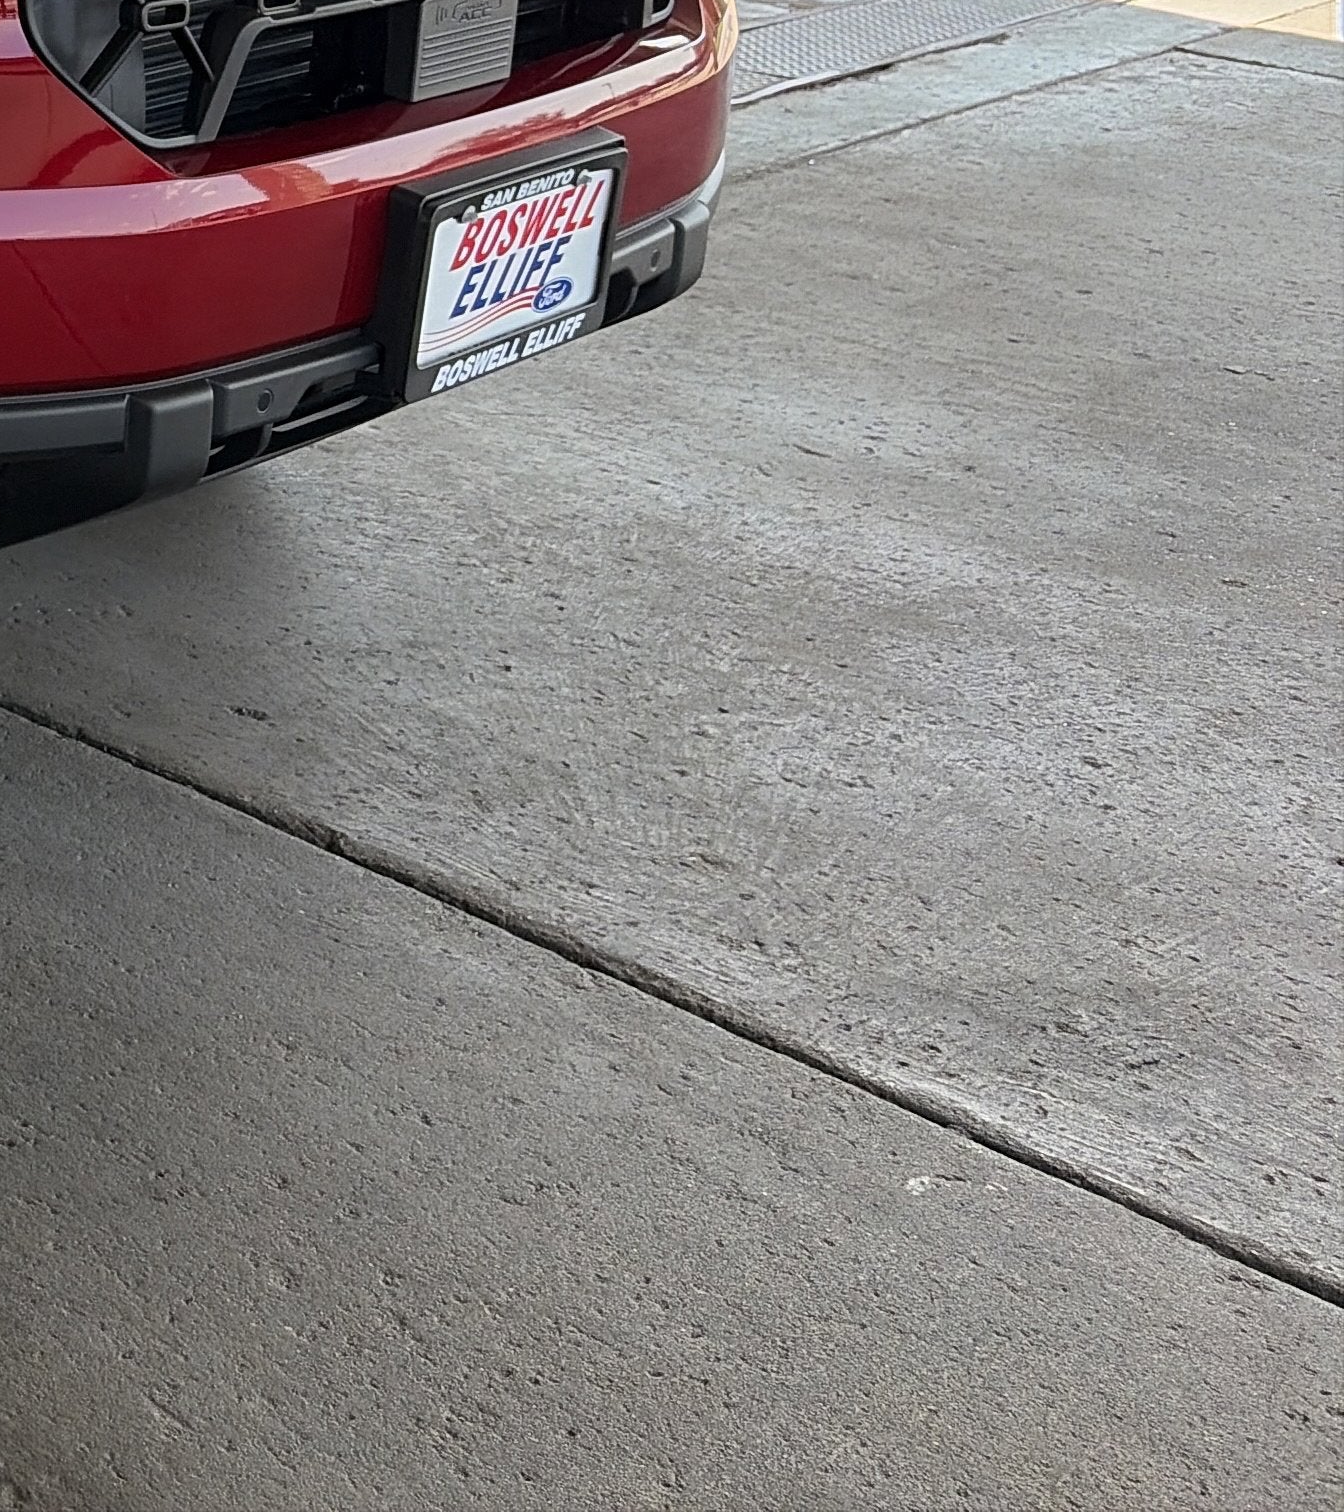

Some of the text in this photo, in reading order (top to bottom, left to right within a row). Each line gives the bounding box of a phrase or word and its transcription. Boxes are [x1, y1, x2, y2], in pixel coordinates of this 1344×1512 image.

[459, 6, 492, 22] ACC
[449, 180, 605, 272] BOSWELL
[480, 168, 575, 211] SAN BENITO
[448, 234, 573, 319] ELLIFF
[431, 313, 586, 393] BOSWELL ELLIFF
